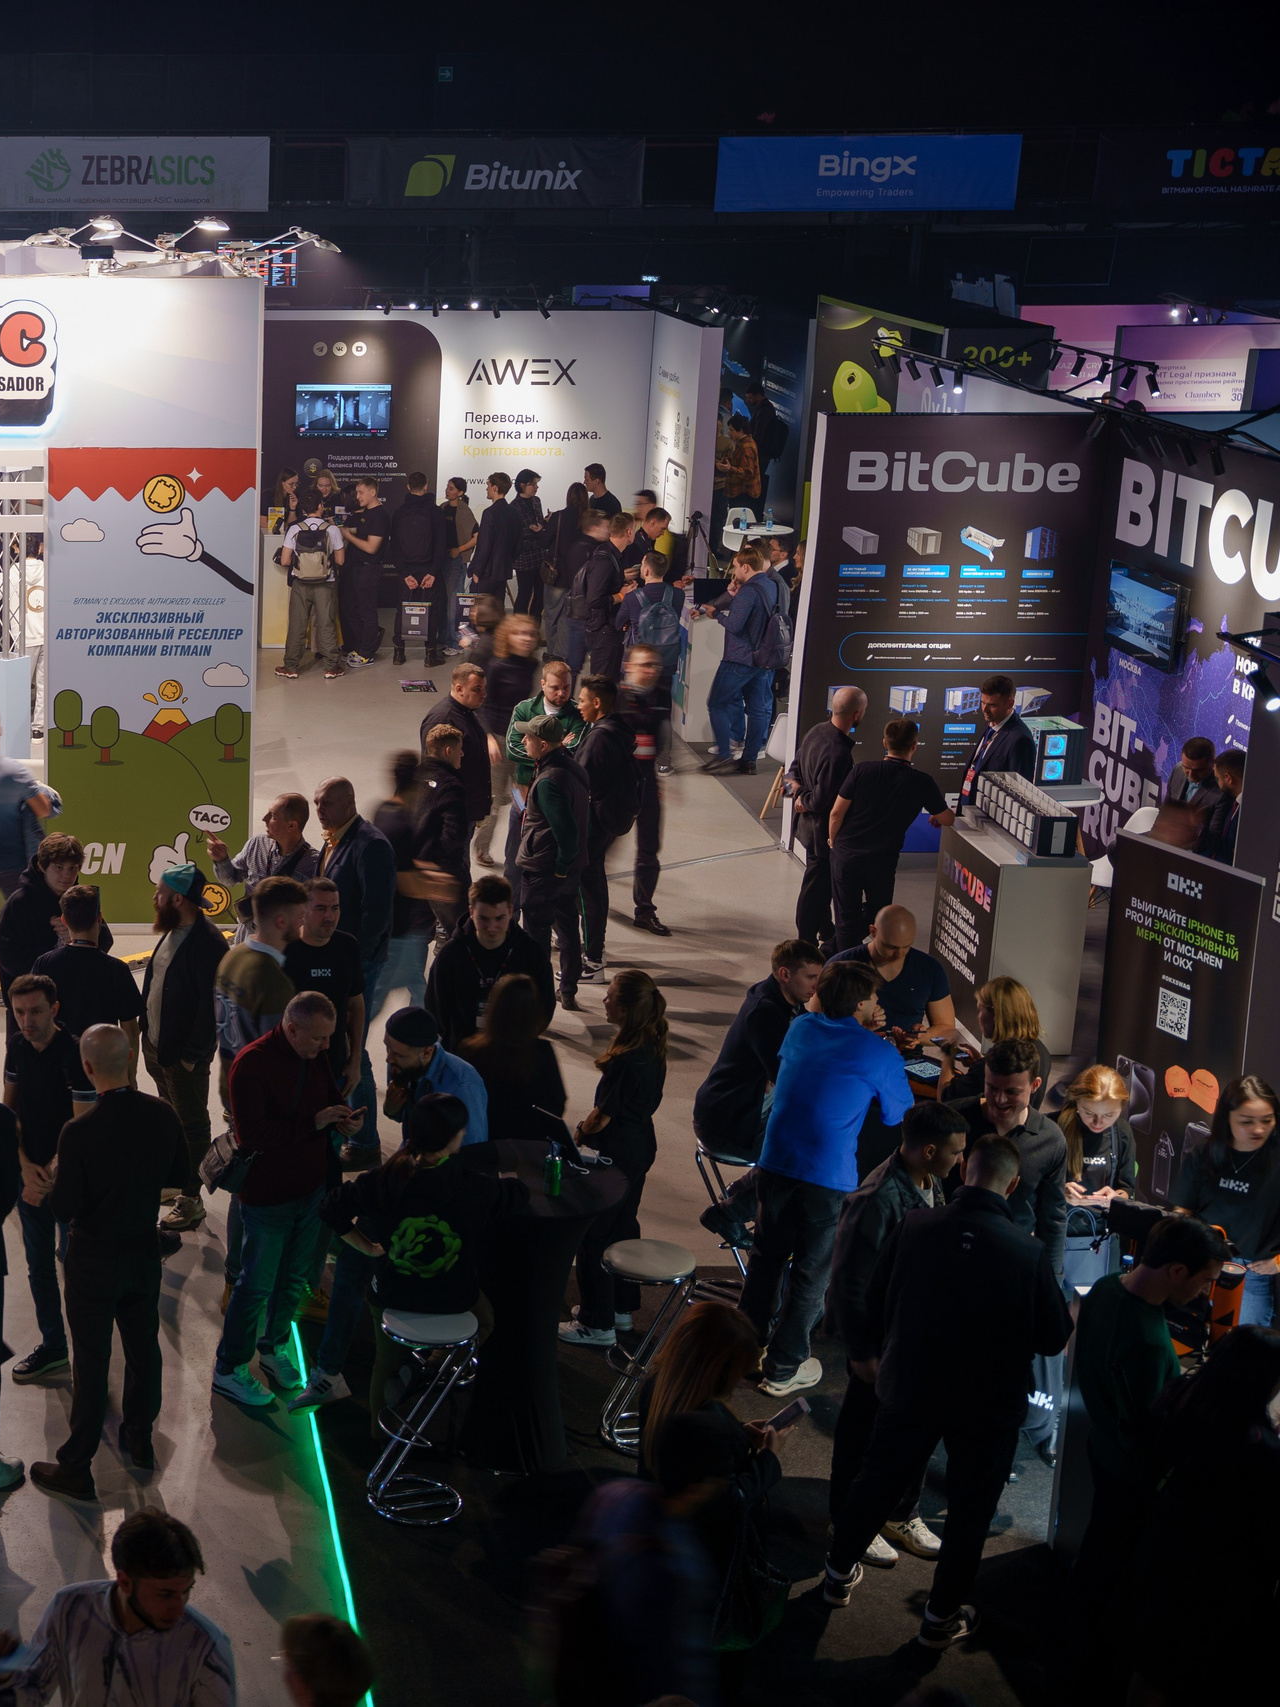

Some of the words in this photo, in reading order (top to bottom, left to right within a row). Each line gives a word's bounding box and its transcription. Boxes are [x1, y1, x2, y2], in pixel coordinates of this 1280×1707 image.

[82, 155, 216, 186] ZEBRASICS
[464, 161, 582, 192] Bitunix
[1166, 147, 1280, 178] TICTA
[816, 188, 874, 198] Empowering
[878, 188, 914, 197] Traders
[1230, 185, 1275, 193] HASHRATE
[466, 359, 578, 386] AWEX
[1170, 371, 1192, 379] Legal
[1197, 371, 1237, 379] признана
[464, 411, 539, 425] Переводы.
[464, 428, 521, 442] Покупка
[525, 431, 533, 440] и
[537, 431, 602, 442] продажа.
[463, 445, 566, 458] Криптовалюта.
[847, 451, 1081, 493] BitCube
[1115, 459, 1280, 600] BITCU
[96, 609, 205, 624] ЭКСКЛЮЗИВНЫЙ
[109, 597, 145, 606] EXCLUSIVE
[148, 597, 191, 606] AUTHORIZED
[192, 597, 227, 606] RESELLER
[56, 626, 175, 640] АВТОРИЗОВАННЫЙ
[178, 628, 244, 640] РЕСЕЛЛЕР
[87, 644, 158, 657] КОМПАНИИ
[160, 644, 213, 657] BITMAIN
[1092, 701, 1144, 760] BIT-
[193, 811, 229, 825] TACC
[943, 850, 993, 913] BITCUBE
[1167, 872, 1203, 900] OKX
[940, 886, 976, 926] КОНТЕЙНЕРЫ
[1131, 896, 1187, 927] ВЫИГРАЙТЕ
[1187, 918, 1224, 941] IPHONE
[1225, 933, 1236, 945] 15
[941, 918, 977, 957] ВОЗДУШНЫМ
[949, 907, 980, 945] МАЙНИНГА
[1125, 908, 1144, 923] PRO
[1144, 917, 1152, 928] И
[1153, 919, 1239, 961] ЭКСКЛЮЗИВНЫЙ
[934, 938, 976, 984] ОХЛАЖДЕНИЕМ
[940, 930, 968, 963] ВОДЯНЫМ
[1136, 926, 1162, 945] МЕРЧ
[1163, 937, 1176, 950] ОТ
[1176, 942, 1223, 970] MCLAREN
[1164, 951, 1171, 963] И
[1172, 955, 1193, 971] OKX
